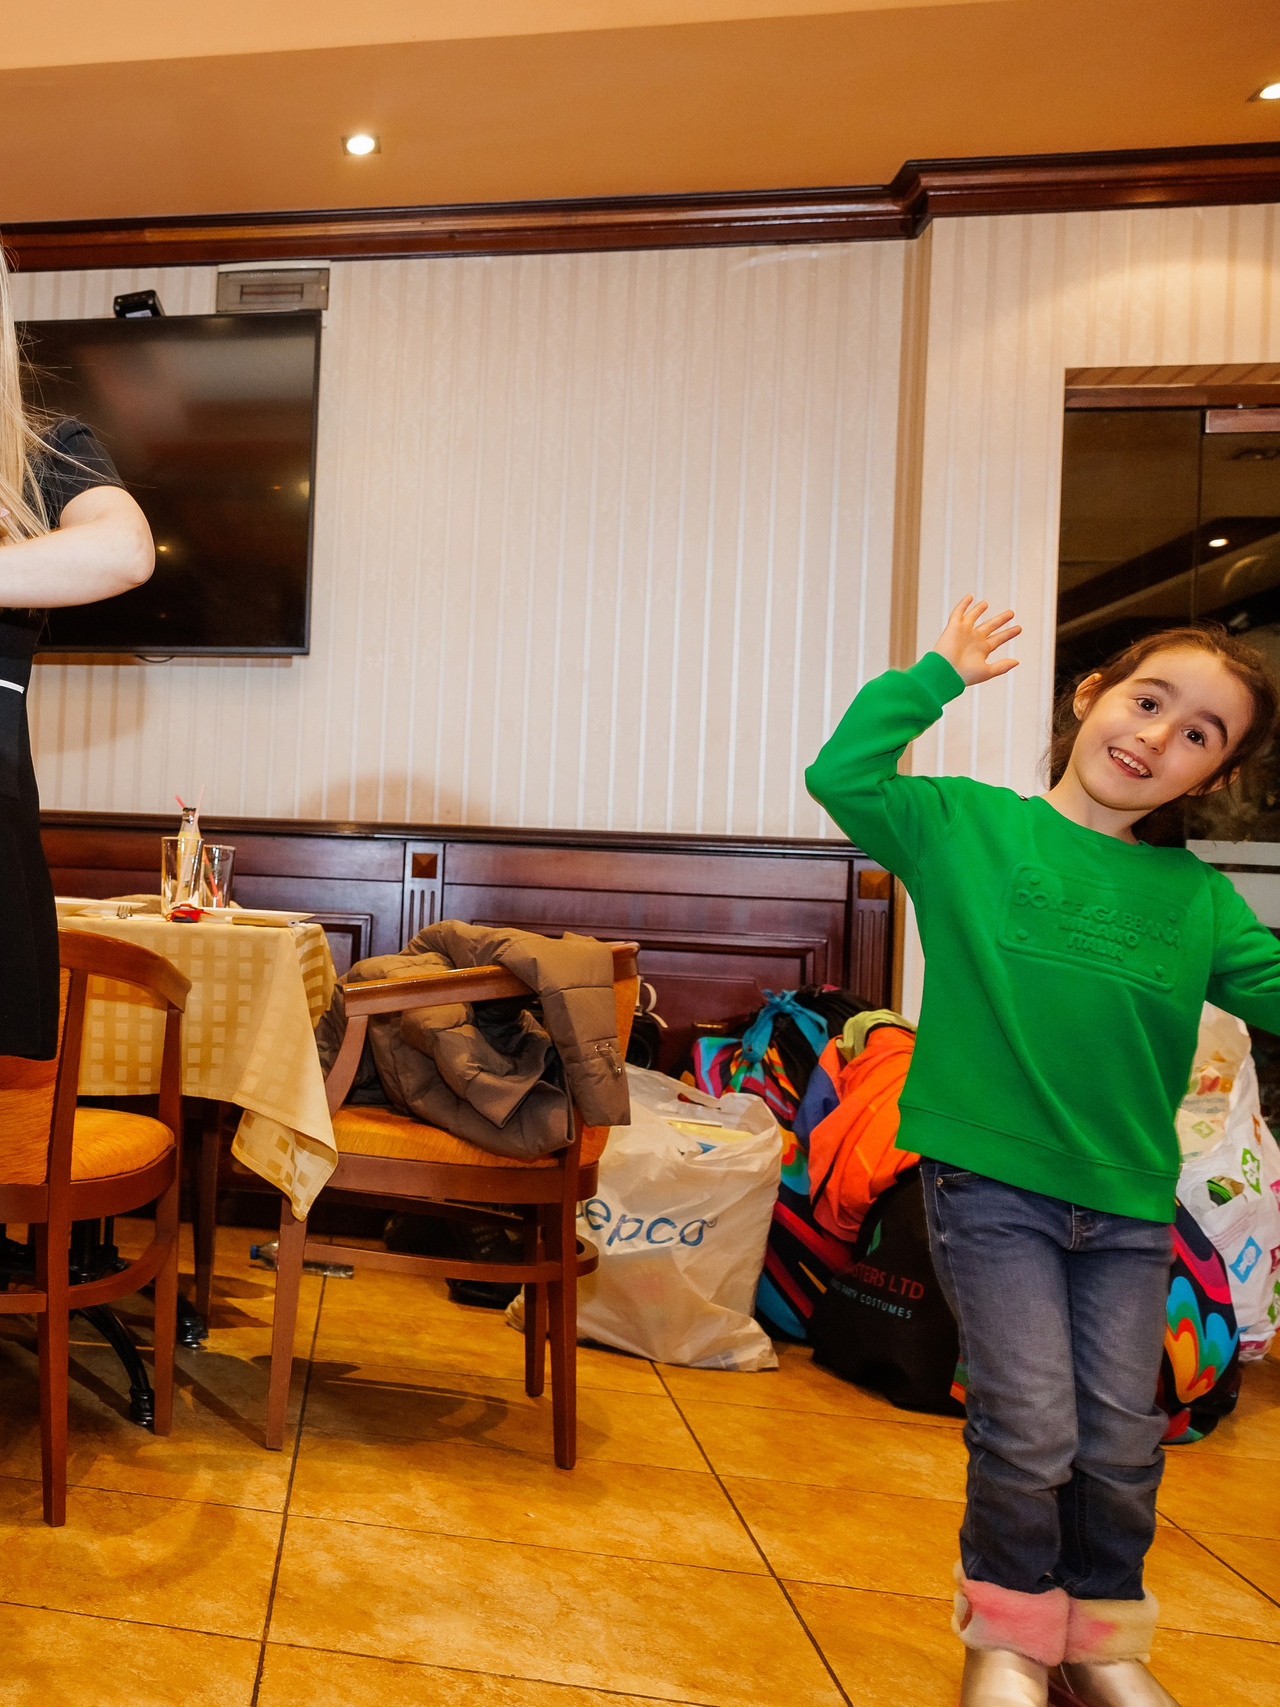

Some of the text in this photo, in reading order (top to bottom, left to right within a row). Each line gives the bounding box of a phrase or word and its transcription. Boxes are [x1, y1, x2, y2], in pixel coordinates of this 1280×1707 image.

[576, 1199, 705, 1247] epco
[888, 1275, 925, 1299] LTD
[860, 1294, 913, 1319] COSTUMES
